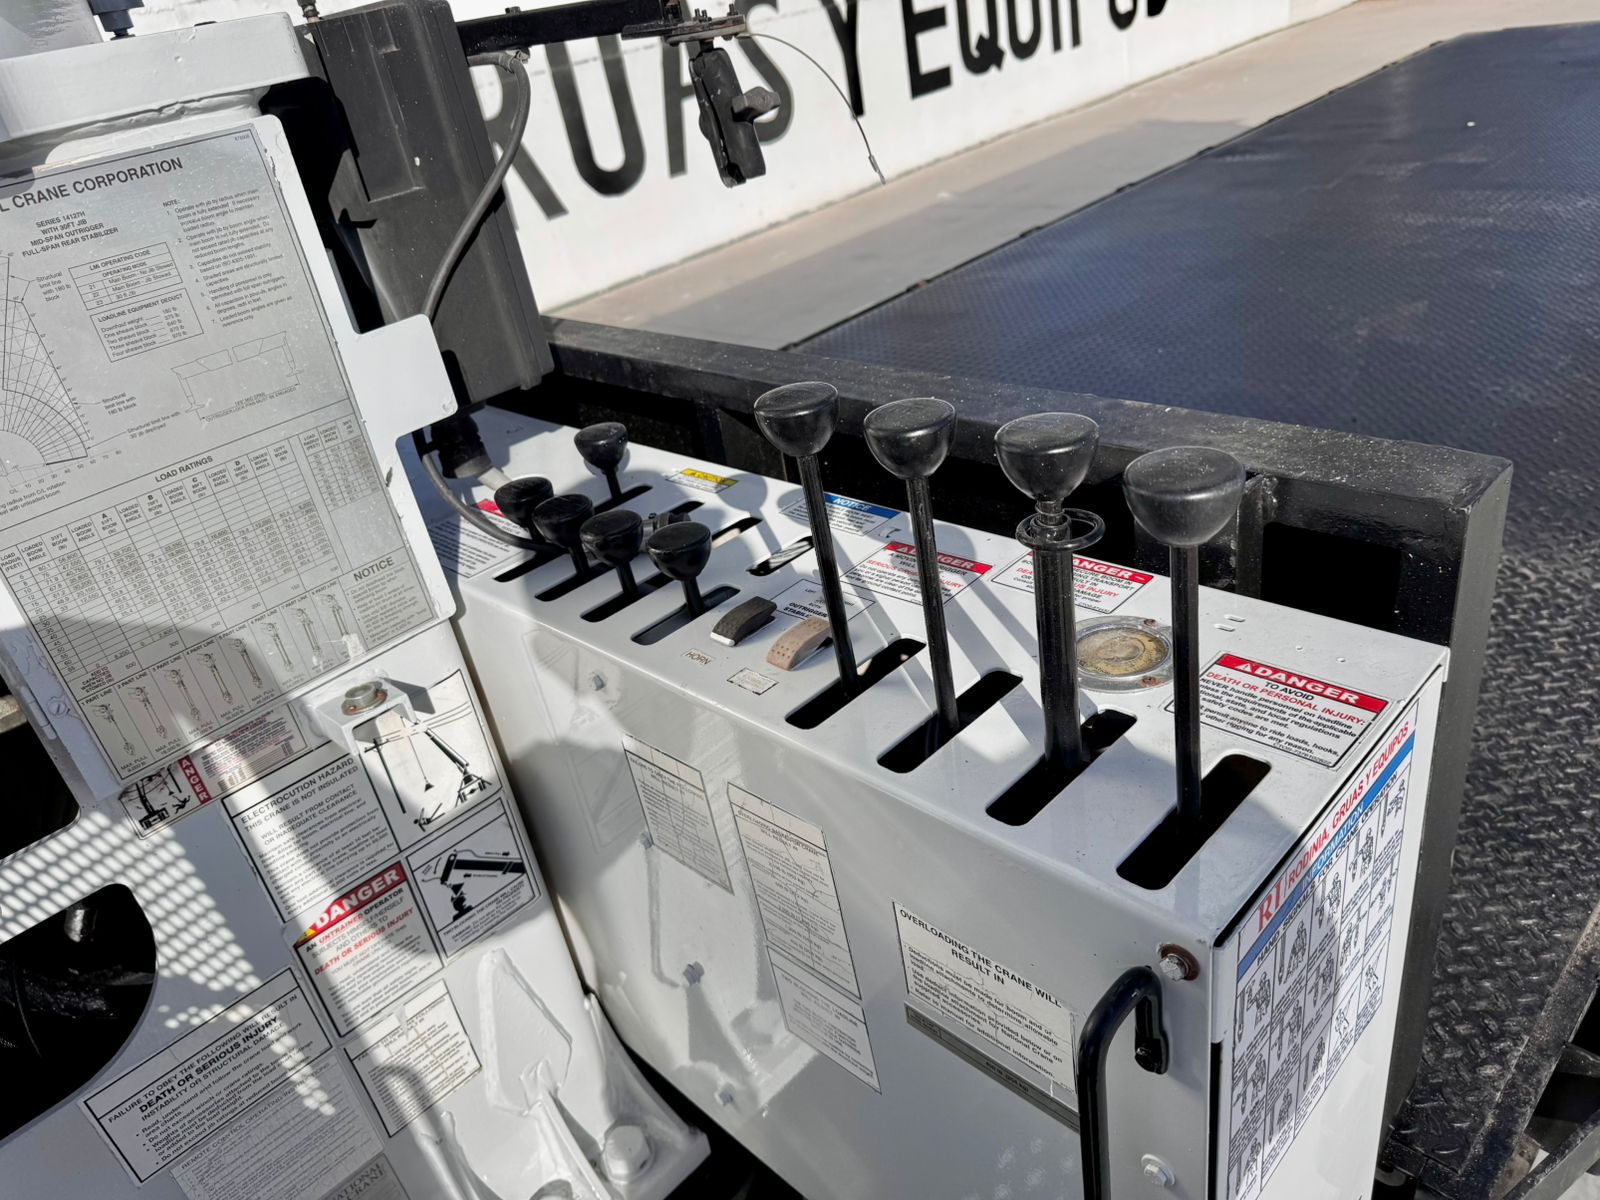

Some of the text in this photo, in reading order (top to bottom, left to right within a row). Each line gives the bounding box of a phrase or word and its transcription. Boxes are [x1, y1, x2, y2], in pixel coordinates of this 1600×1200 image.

[820, 0, 864, 118] Y
[10, 183, 71, 209] CRANE
[71, 157, 183, 194] CORPORATION
[29, 222, 104, 246] MID-SPAN OUTRIGGER
[35, 216, 61, 228] SERIES
[40, 218, 88, 235] WITH 30FT JIB
[21, 226, 119, 257] FULL-SPAN REAR STABILIZER
[100, 249, 151, 267] OPERATING CODE
[127, 300, 160, 314] EQUIPMENT
[154, 455, 213, 482] LOAD RATINGS
[832, 497, 872, 510] NOTICE
[353, 555, 394, 582] NOTICE
[1072, 557, 1133, 579] ANGER
[1090, 576, 1134, 590] TRANSPORT
[1087, 585, 1120, 597] INJURY
[686, 651, 711, 665] HORN
[1198, 678, 1228, 690] NEVER
[1228, 687, 1258, 699] handle
[1258, 696, 1302, 713] personnel
[1316, 715, 1353, 729] loadline
[1205, 671, 1367, 725] DEATH OR PERSONAL INJURY:
[1254, 666, 1361, 704] DANGER
[1263, 681, 1315, 701] TO AVOID
[1201, 696, 1291, 728] safety codes are met.
[1202, 707, 1229, 719] permit
[1228, 715, 1259, 729] anyone
[1267, 728, 1286, 738] ride
[1204, 713, 1227, 724] other
[1224, 720, 1254, 733] rigging
[1253, 730, 1268, 738] for
[1266, 734, 1284, 743] any
[1219, 690, 1233, 698] the
[1233, 694, 1287, 715] requirements
[1313, 720, 1357, 737] applicable
[1225, 698, 1342, 739] state, and local regulations
[240, 757, 354, 823] ELECTROCUTION HAZARD
[244, 765, 358, 832] THIS CRANE IS NOT INSULATED
[260, 783, 354, 839] WILL RESULT FROM CONTACT
[264, 789, 357, 845] OR INADEQUATE CLEARANCE
[1258, 720, 1409, 933] RI RODINIA, GRUAS Y EQUIPOS
[1301, 801, 1366, 892] INFORMATION
[1257, 771, 1398, 966] HAND SIGNALS FOR CRANE OPERATION
[314, 867, 399, 929] DANGER
[305, 886, 403, 952] AN UNTRAINED OPERATOR
[378, 914, 388, 924] TO
[314, 907, 414, 975] DEATH OR SERIOUS INJURY
[900, 909, 1061, 1008] OVERLOADING THE CRANE WILL
[951, 947, 1004, 985] RESULT IN
[107, 1097, 143, 1123] FAILURE
[143, 1089, 155, 1099] TO
[155, 1073, 178, 1091] OBEY
[179, 1061, 196, 1075] THE
[196, 1031, 241, 1064] FOLLOWING
[289, 994, 297, 1002] IN
[138, 1015, 279, 1113] DEATH OR SERIOUS INJURY
[141, 1086, 188, 1121] INSTABILITY
[188, 1077, 202, 1089] OR
[202, 1043, 252, 1080] STRUCTURAL
[161, 1092, 199, 1120] understand
[181, 1146, 210, 1170] REMOTE
